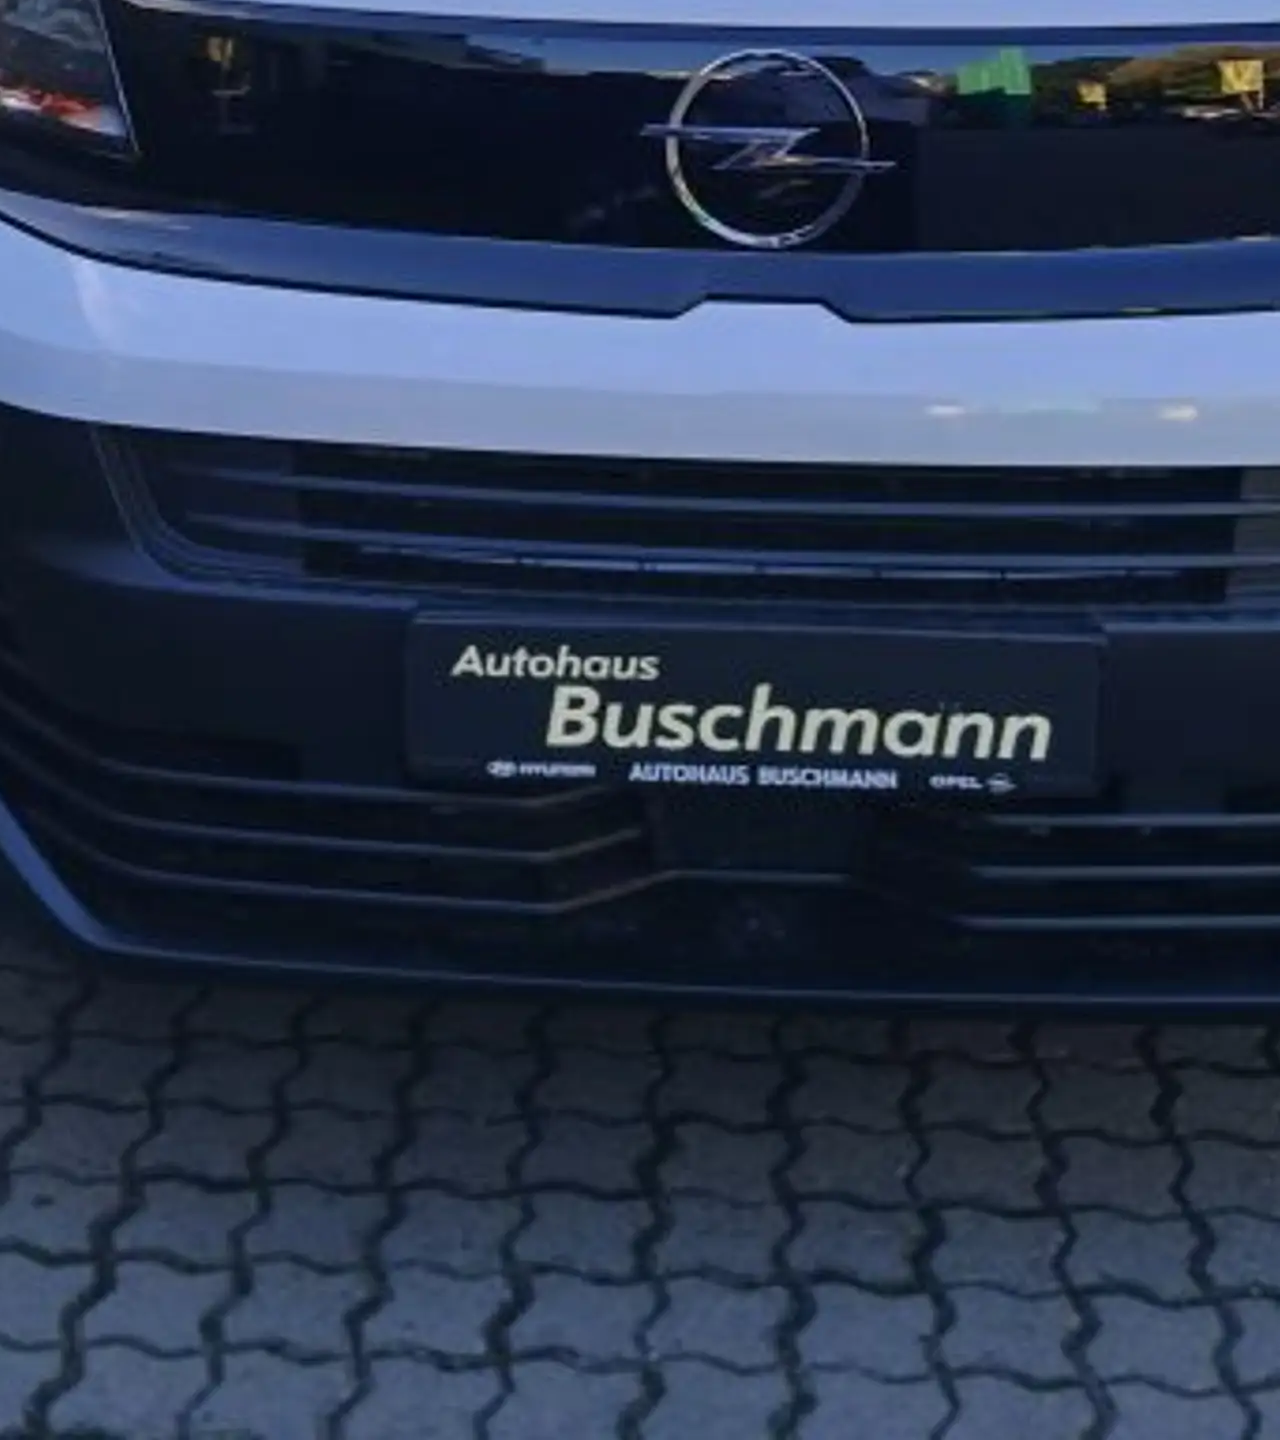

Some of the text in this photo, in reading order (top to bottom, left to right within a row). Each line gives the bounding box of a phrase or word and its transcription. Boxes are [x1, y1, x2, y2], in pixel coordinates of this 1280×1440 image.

[451, 644, 660, 682] Autohaus
[544, 682, 1052, 762] Buschmann
[628, 761, 750, 786] AUTOHAUS
[756, 765, 899, 790] BUSCHMANN
